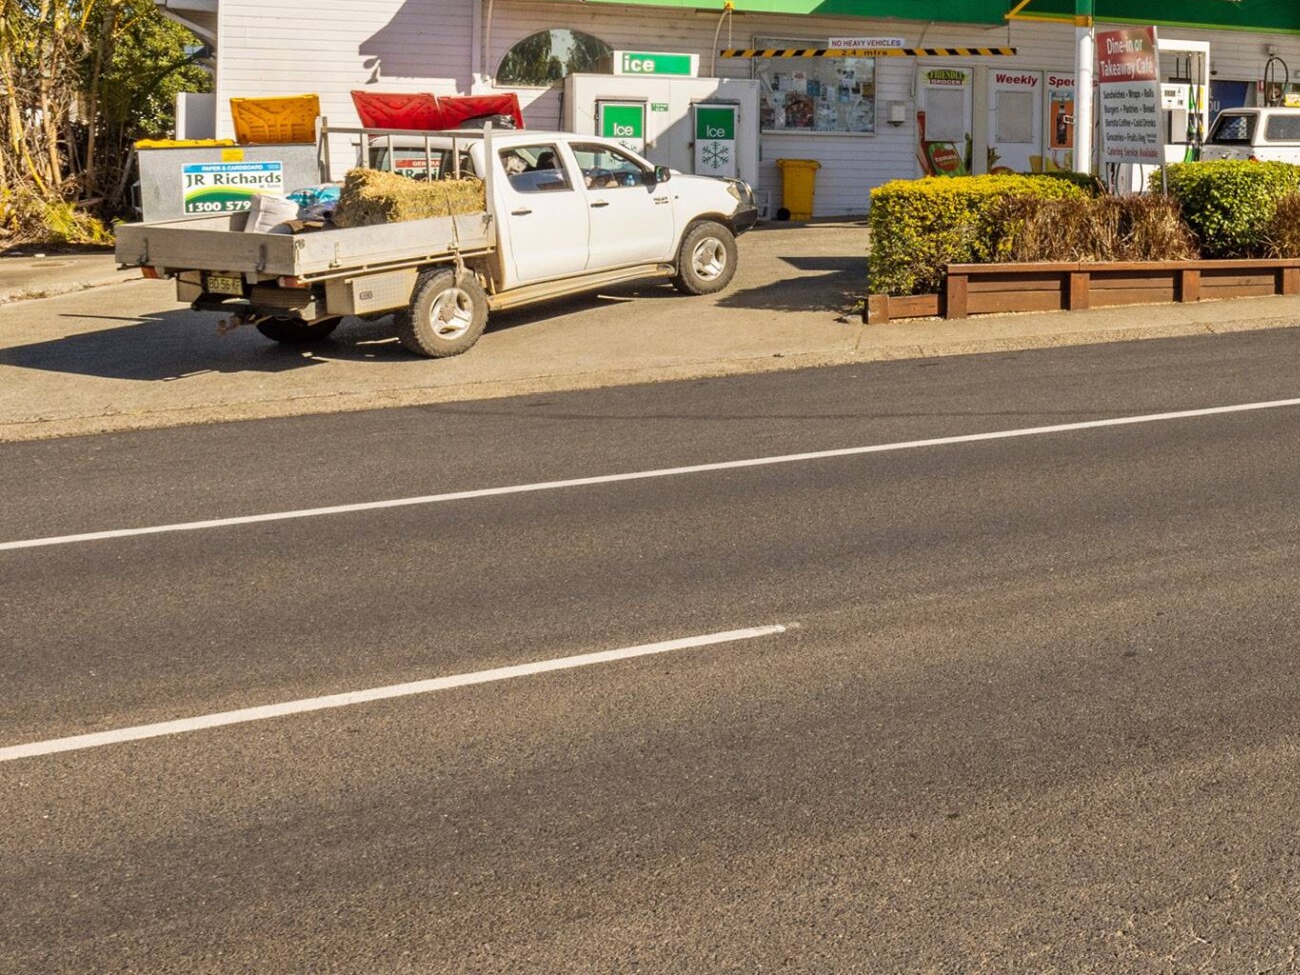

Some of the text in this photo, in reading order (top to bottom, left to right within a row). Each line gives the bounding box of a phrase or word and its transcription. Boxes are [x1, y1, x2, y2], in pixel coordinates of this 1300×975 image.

[867, 39, 902, 47] VEHICLES
[1107, 37, 1143, 54] Dine-in or
[841, 49, 888, 57] 2.4 mtrs
[623, 55, 655, 72] ice
[1100, 55, 1154, 79] Takeaway Café
[996, 73, 1099, 88] Weekly Specs
[613, 123, 634, 137] Ice
[706, 125, 726, 138] Ice
[185, 172, 282, 188] JR Richards
[188, 201, 251, 213] 1300 579
